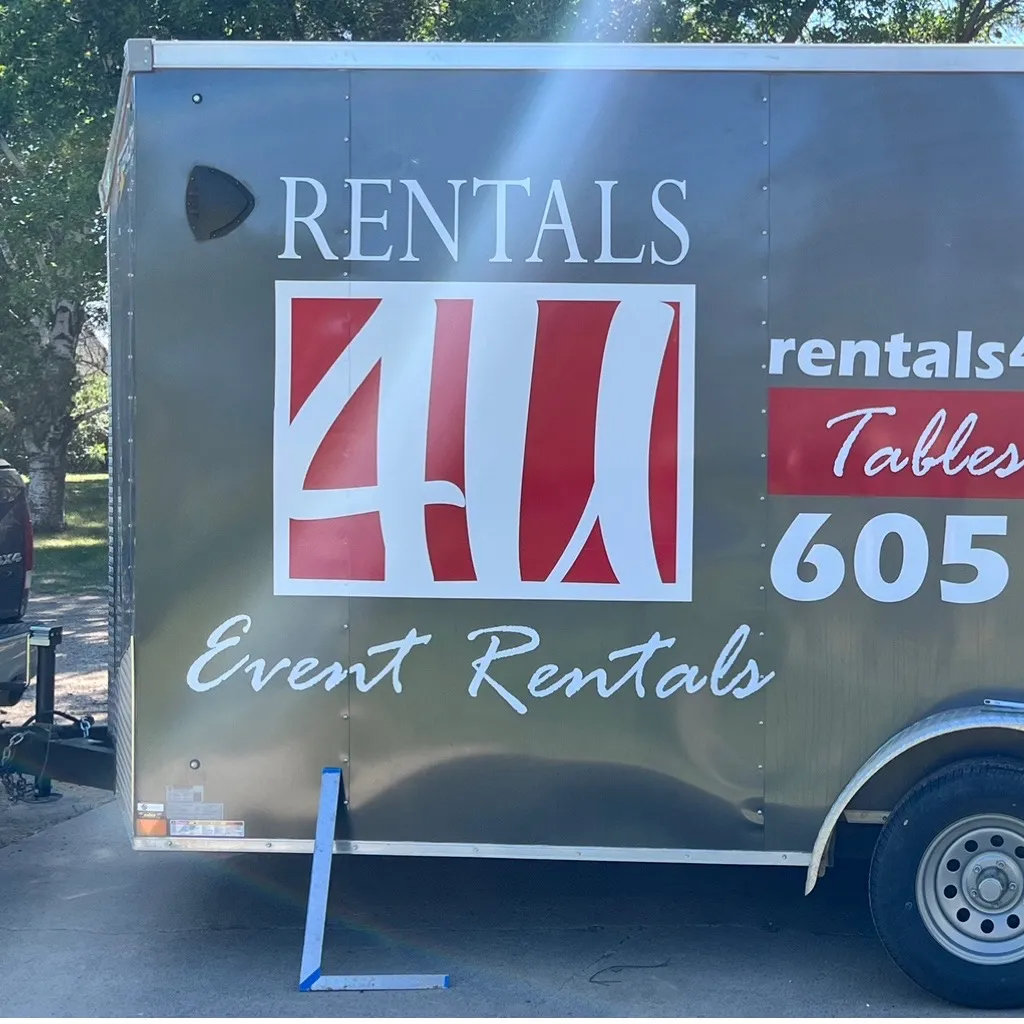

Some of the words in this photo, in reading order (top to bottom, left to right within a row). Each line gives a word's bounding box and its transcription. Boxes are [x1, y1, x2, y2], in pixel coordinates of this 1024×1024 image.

[277, 176, 691, 265] RENTALS
[770, 512, 1009, 604] 605
[186, 614, 432, 695] Event
[467, 624, 775, 714] Rentals
